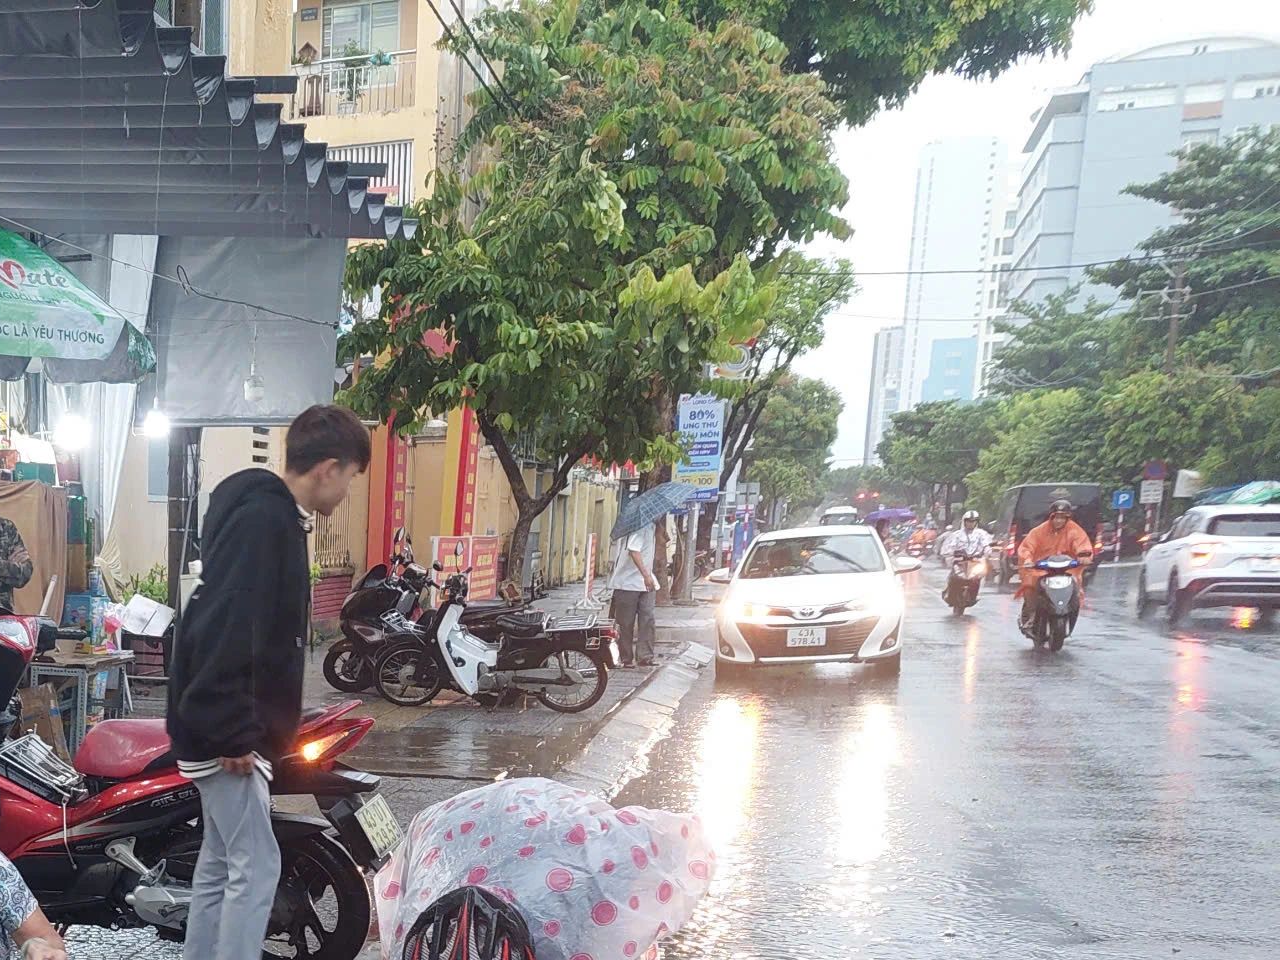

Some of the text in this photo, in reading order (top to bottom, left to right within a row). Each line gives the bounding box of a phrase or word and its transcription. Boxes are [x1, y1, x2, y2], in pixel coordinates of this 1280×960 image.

[14, 322, 29, 337] LÀ
[32, 323, 54, 340] YÊU
[57, 327, 105, 345] THƯƠNG
[689, 409, 716, 421] 80%
[702, 420, 720, 429] THƯ
[1118, 492, 1130, 505] P
[798, 628, 815, 637] 43A
[791, 636, 821, 646] 578.41
